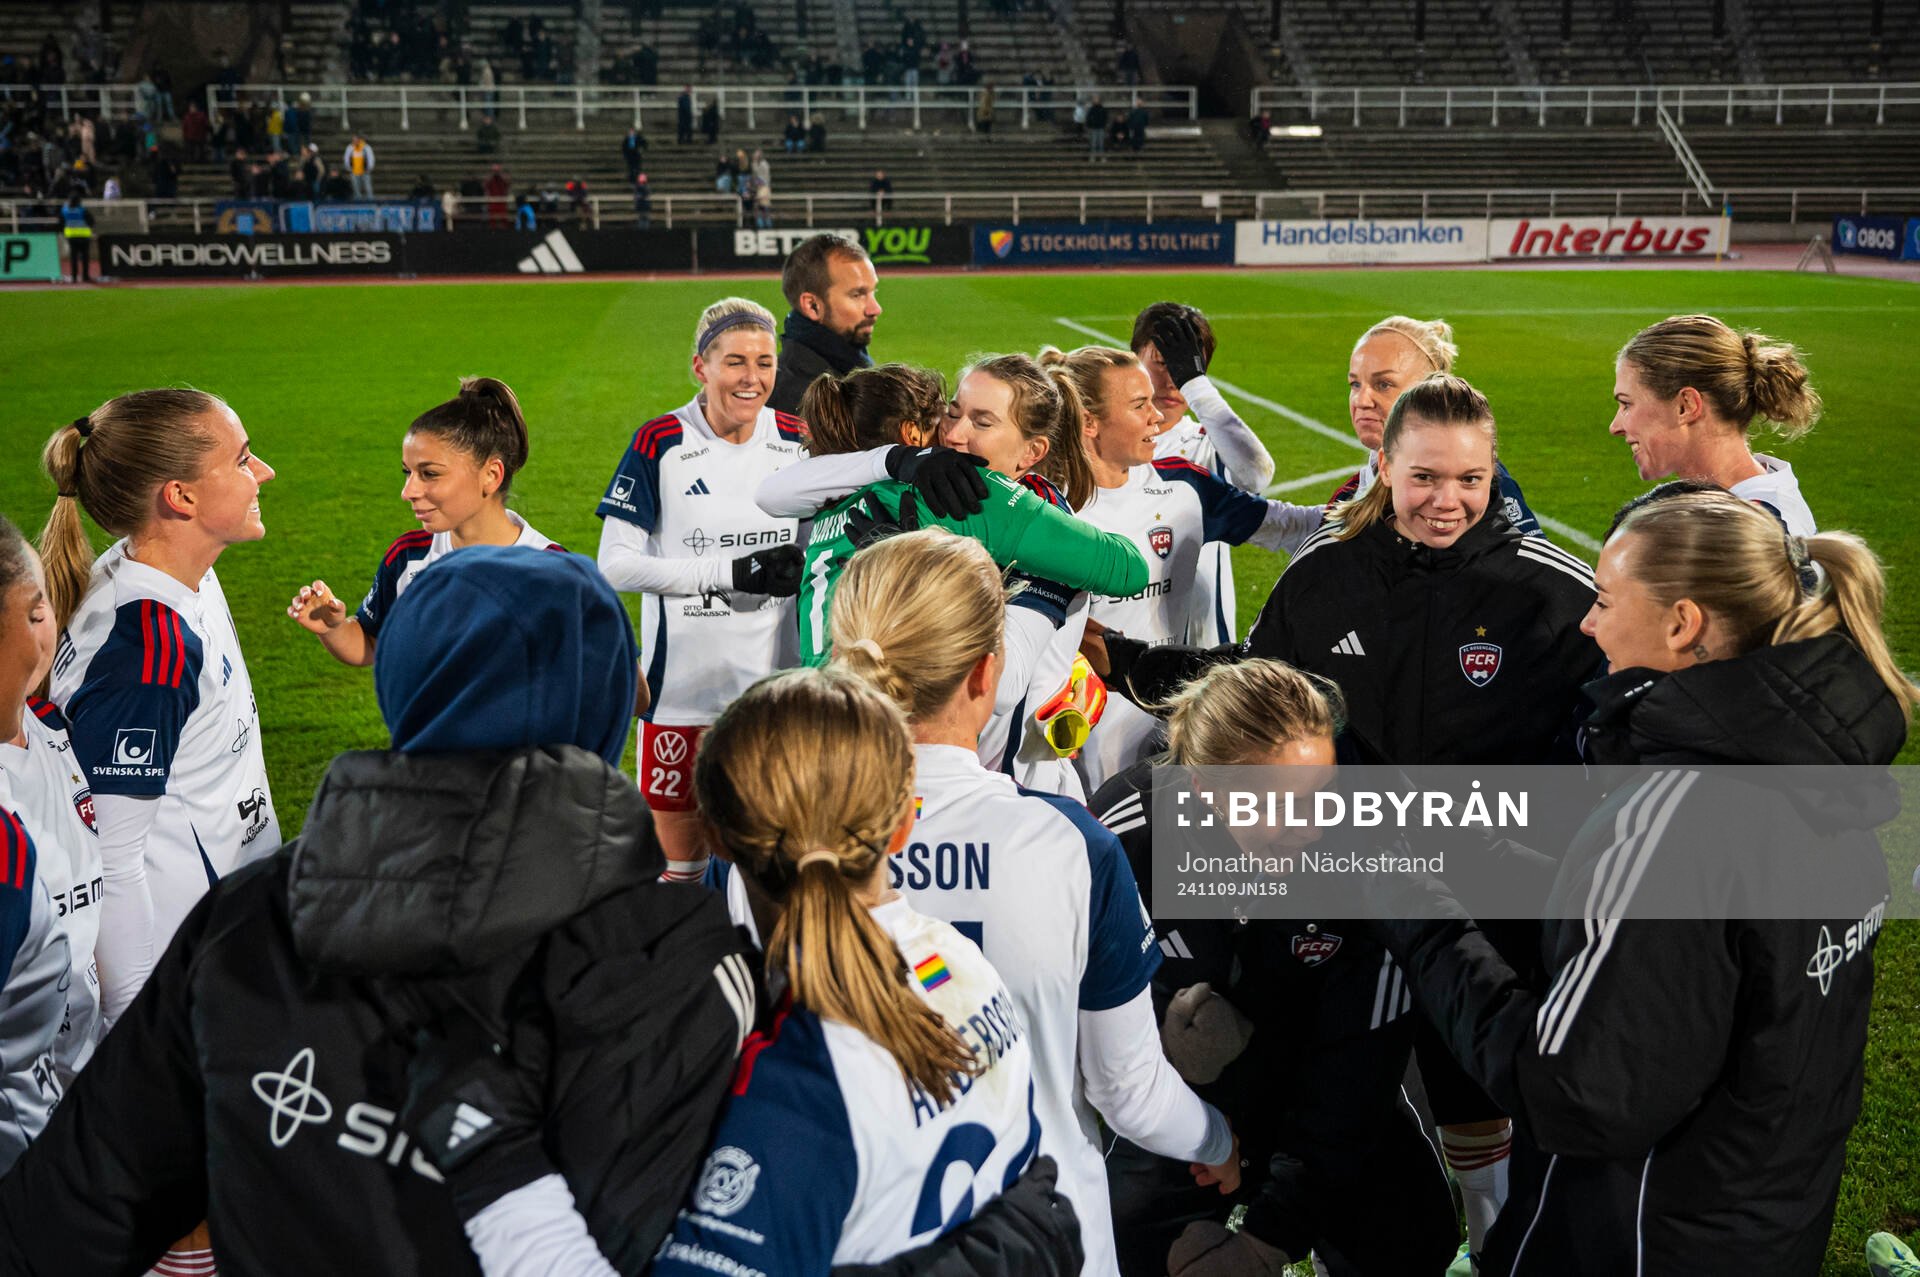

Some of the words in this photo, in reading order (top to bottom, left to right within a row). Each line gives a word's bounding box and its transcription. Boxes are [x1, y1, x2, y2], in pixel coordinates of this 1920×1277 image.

[865, 227, 931, 254] YOU
[1020, 234, 1132, 252] STOCKHOLMS
[1139, 233, 1221, 250] STOLTHET
[1262, 220, 1464, 246] Handelsbanken
[1509, 218, 1711, 255] Interbus
[1858, 227, 1895, 250] OBOS
[682, 604, 703, 612] OTTO
[1465, 653, 1496, 665] FCR
[92, 766, 142, 776] SVENSKA
[649, 767, 682, 797] 22
[1297, 942, 1333, 954] FCR
